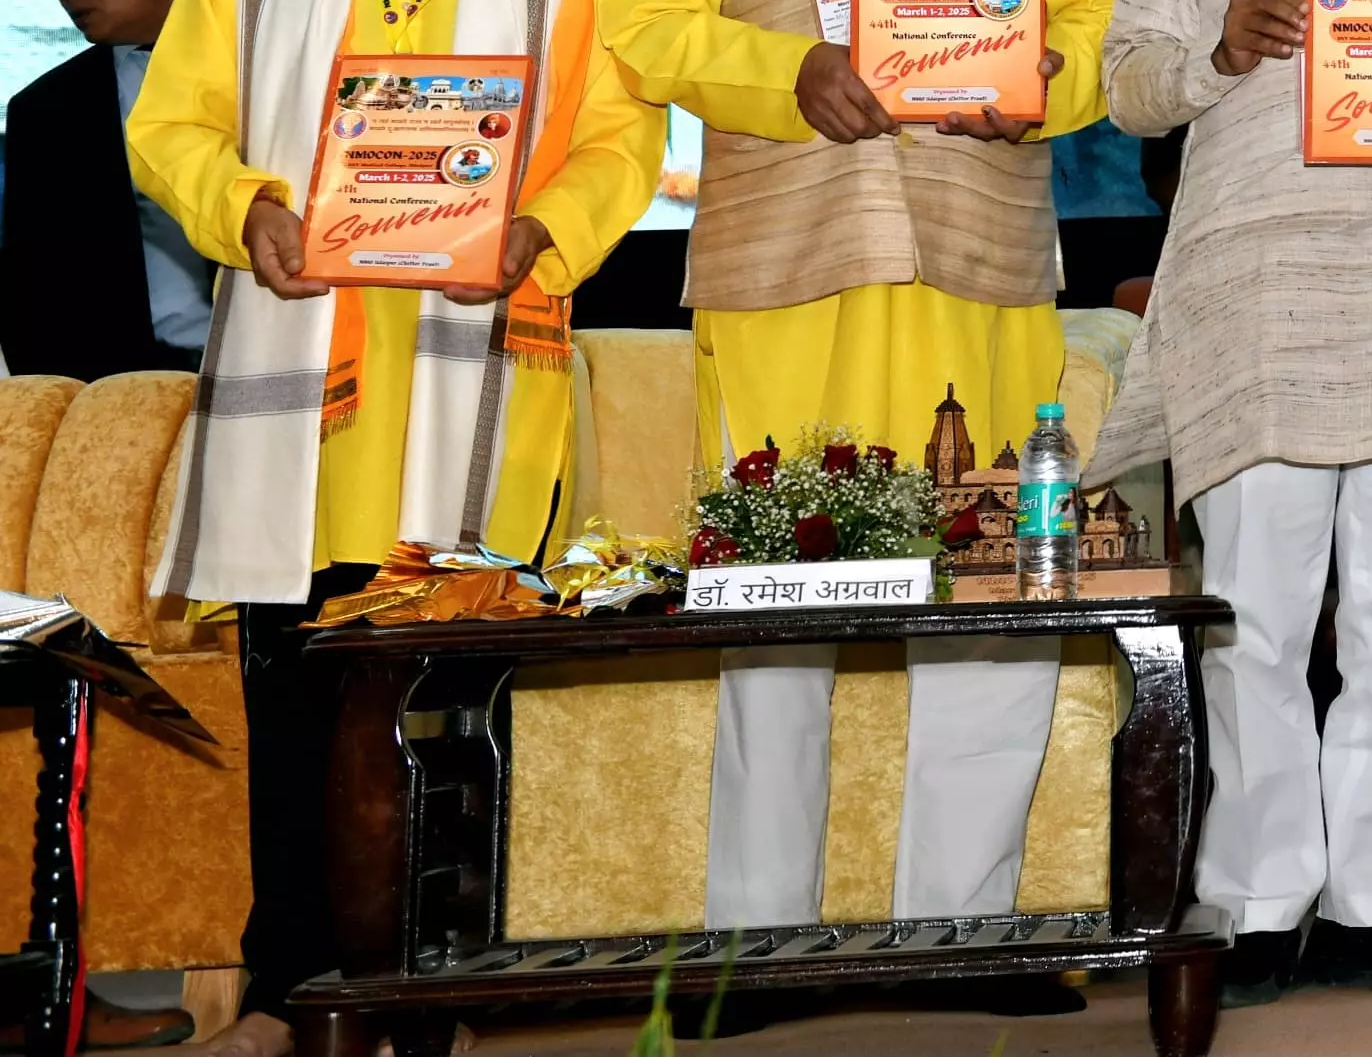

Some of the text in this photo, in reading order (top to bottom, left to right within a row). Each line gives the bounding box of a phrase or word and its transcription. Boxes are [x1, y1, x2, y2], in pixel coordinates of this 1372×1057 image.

[897, 7, 928, 16] March
[948, 8, 970, 16] 2025
[892, 31, 977, 40] National Conference
[871, 24, 1028, 91] Souvenir
[345, 150, 437, 160] NMOCON-2025
[359, 173, 390, 182] March
[411, 174, 435, 182] 2025
[390, 197, 438, 205] Conference
[316, 191, 492, 253] Souvenir
[692, 576, 914, 607] डॉ. रमेश अग्रवाल
